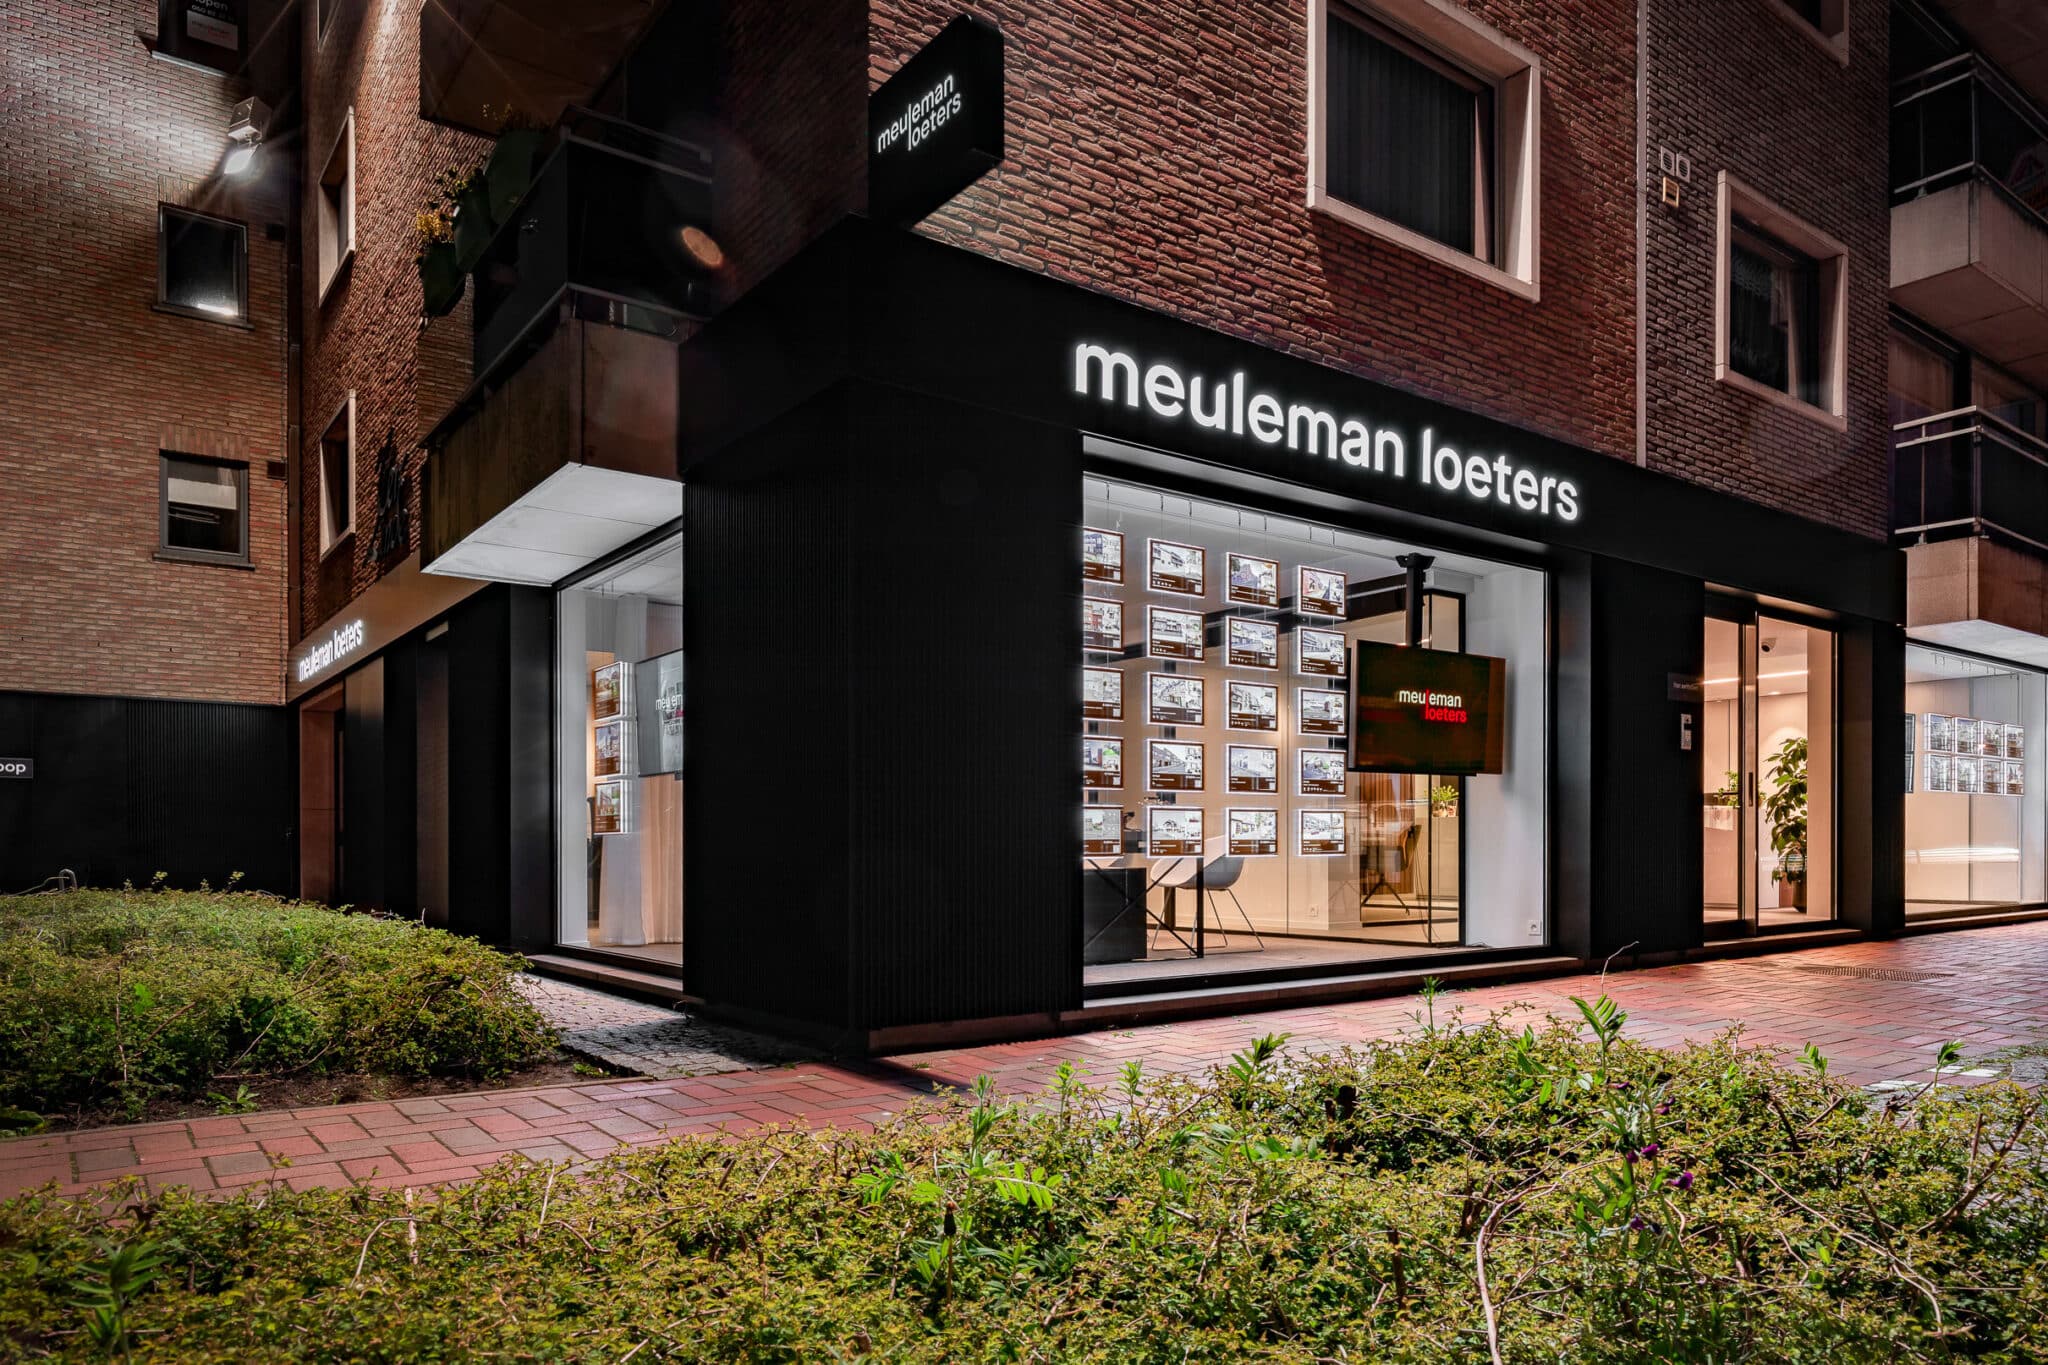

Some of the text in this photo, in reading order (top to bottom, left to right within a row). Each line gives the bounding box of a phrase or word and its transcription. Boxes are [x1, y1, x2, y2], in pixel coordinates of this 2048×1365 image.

[195, 0, 229, 12] open
[878, 74, 953, 153] meuleman
[908, 93, 961, 151] loeters
[1075, 342, 1579, 521] meuleman loeters
[299, 619, 363, 682] meuleman loeters
[1399, 689, 1462, 708] meuleman
[1425, 696, 1468, 722] loeters
